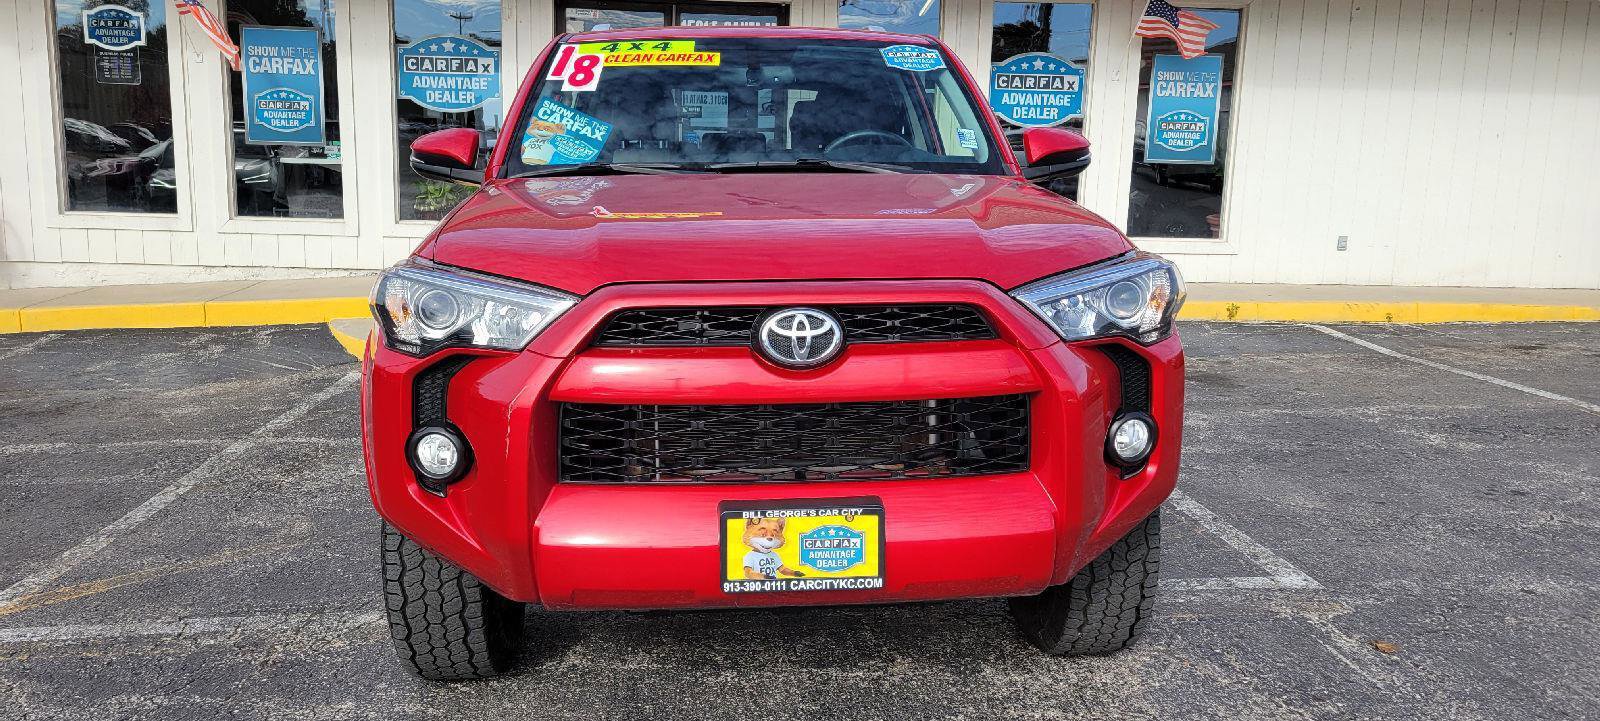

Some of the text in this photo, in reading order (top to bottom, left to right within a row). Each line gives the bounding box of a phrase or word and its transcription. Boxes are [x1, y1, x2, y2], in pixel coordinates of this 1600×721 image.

[92, 19, 138, 29] CARFAX
[95, 28, 135, 37] ADVANTAGE
[248, 45, 316, 58] SHOW ME THE
[604, 54, 715, 63] CLEAN CARFAX
[249, 57, 316, 75] CARFAX
[406, 57, 493, 74] CARFAX
[551, 46, 600, 87] 18
[1157, 71, 1216, 82] SHOW ME THE
[412, 76, 488, 89] ADVANTAGE
[997, 75, 1077, 90] CARFAX
[1156, 81, 1215, 98] CARFAX
[426, 90, 475, 103] DEALER
[1001, 93, 1071, 106] ADVANTAGE
[259, 101, 309, 111] CARFAX
[263, 110, 306, 119] ADVANTAGE
[543, 100, 609, 131] SHOW ME THE
[1012, 107, 1059, 119] DEALER
[537, 107, 607, 141] CARFAX
[1160, 122, 1205, 131] CARFAX
[742, 508, 863, 519] BILL GEORGE'S CAR CITY
[805, 539, 860, 548] CARFAX
[809, 550, 856, 559] ADVANTAGE
[759, 558, 775, 566] CAR
[816, 559, 848, 567] DEALER
[760, 567, 776, 575] FOX
[723, 578, 883, 592] 913-390-0111 CARCITYKC.COM
